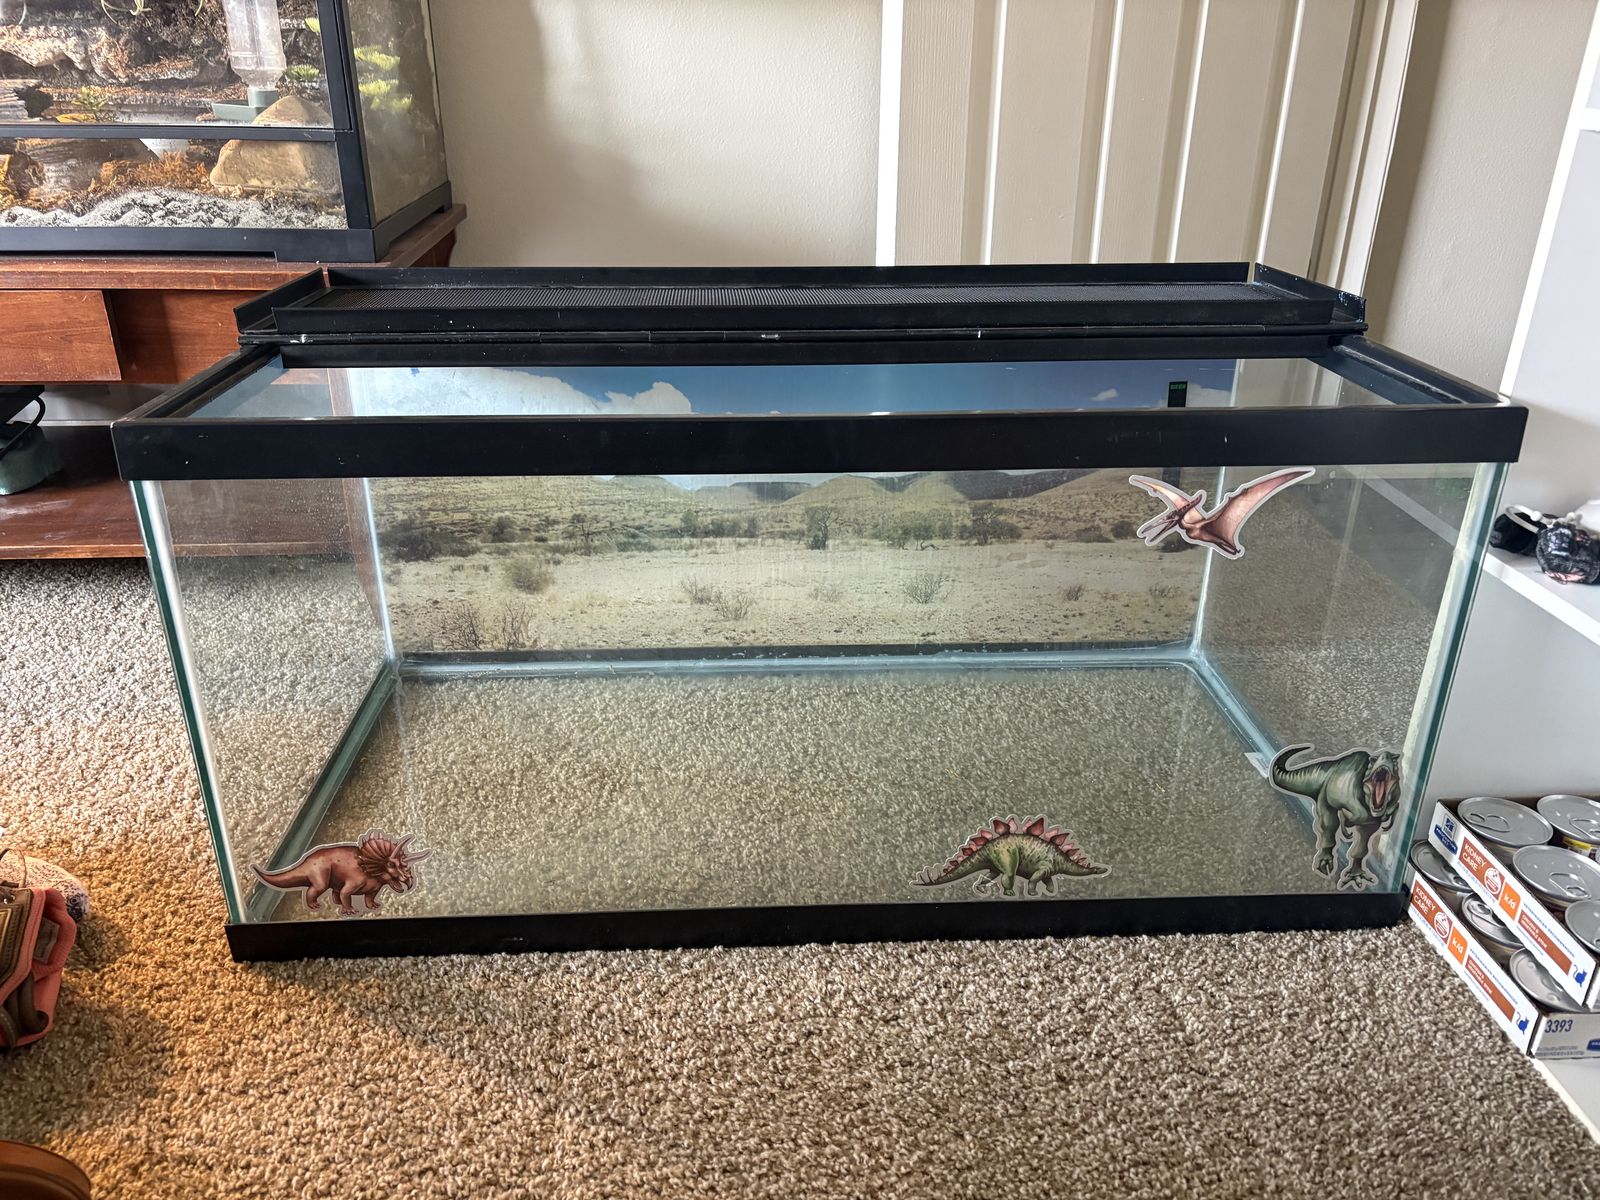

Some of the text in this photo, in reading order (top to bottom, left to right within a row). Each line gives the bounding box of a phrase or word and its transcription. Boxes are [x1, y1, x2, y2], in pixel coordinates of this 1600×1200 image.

[1462, 852, 1478, 871] CARE
[1464, 843, 1487, 867] KIDNEY
[1413, 895, 1429, 914] CARE
[1415, 886, 1436, 911] KIDNEY
[1503, 894, 1516, 910] k/d
[1451, 938, 1464, 954] k/d
[1544, 1019, 1573, 1033] 3393
